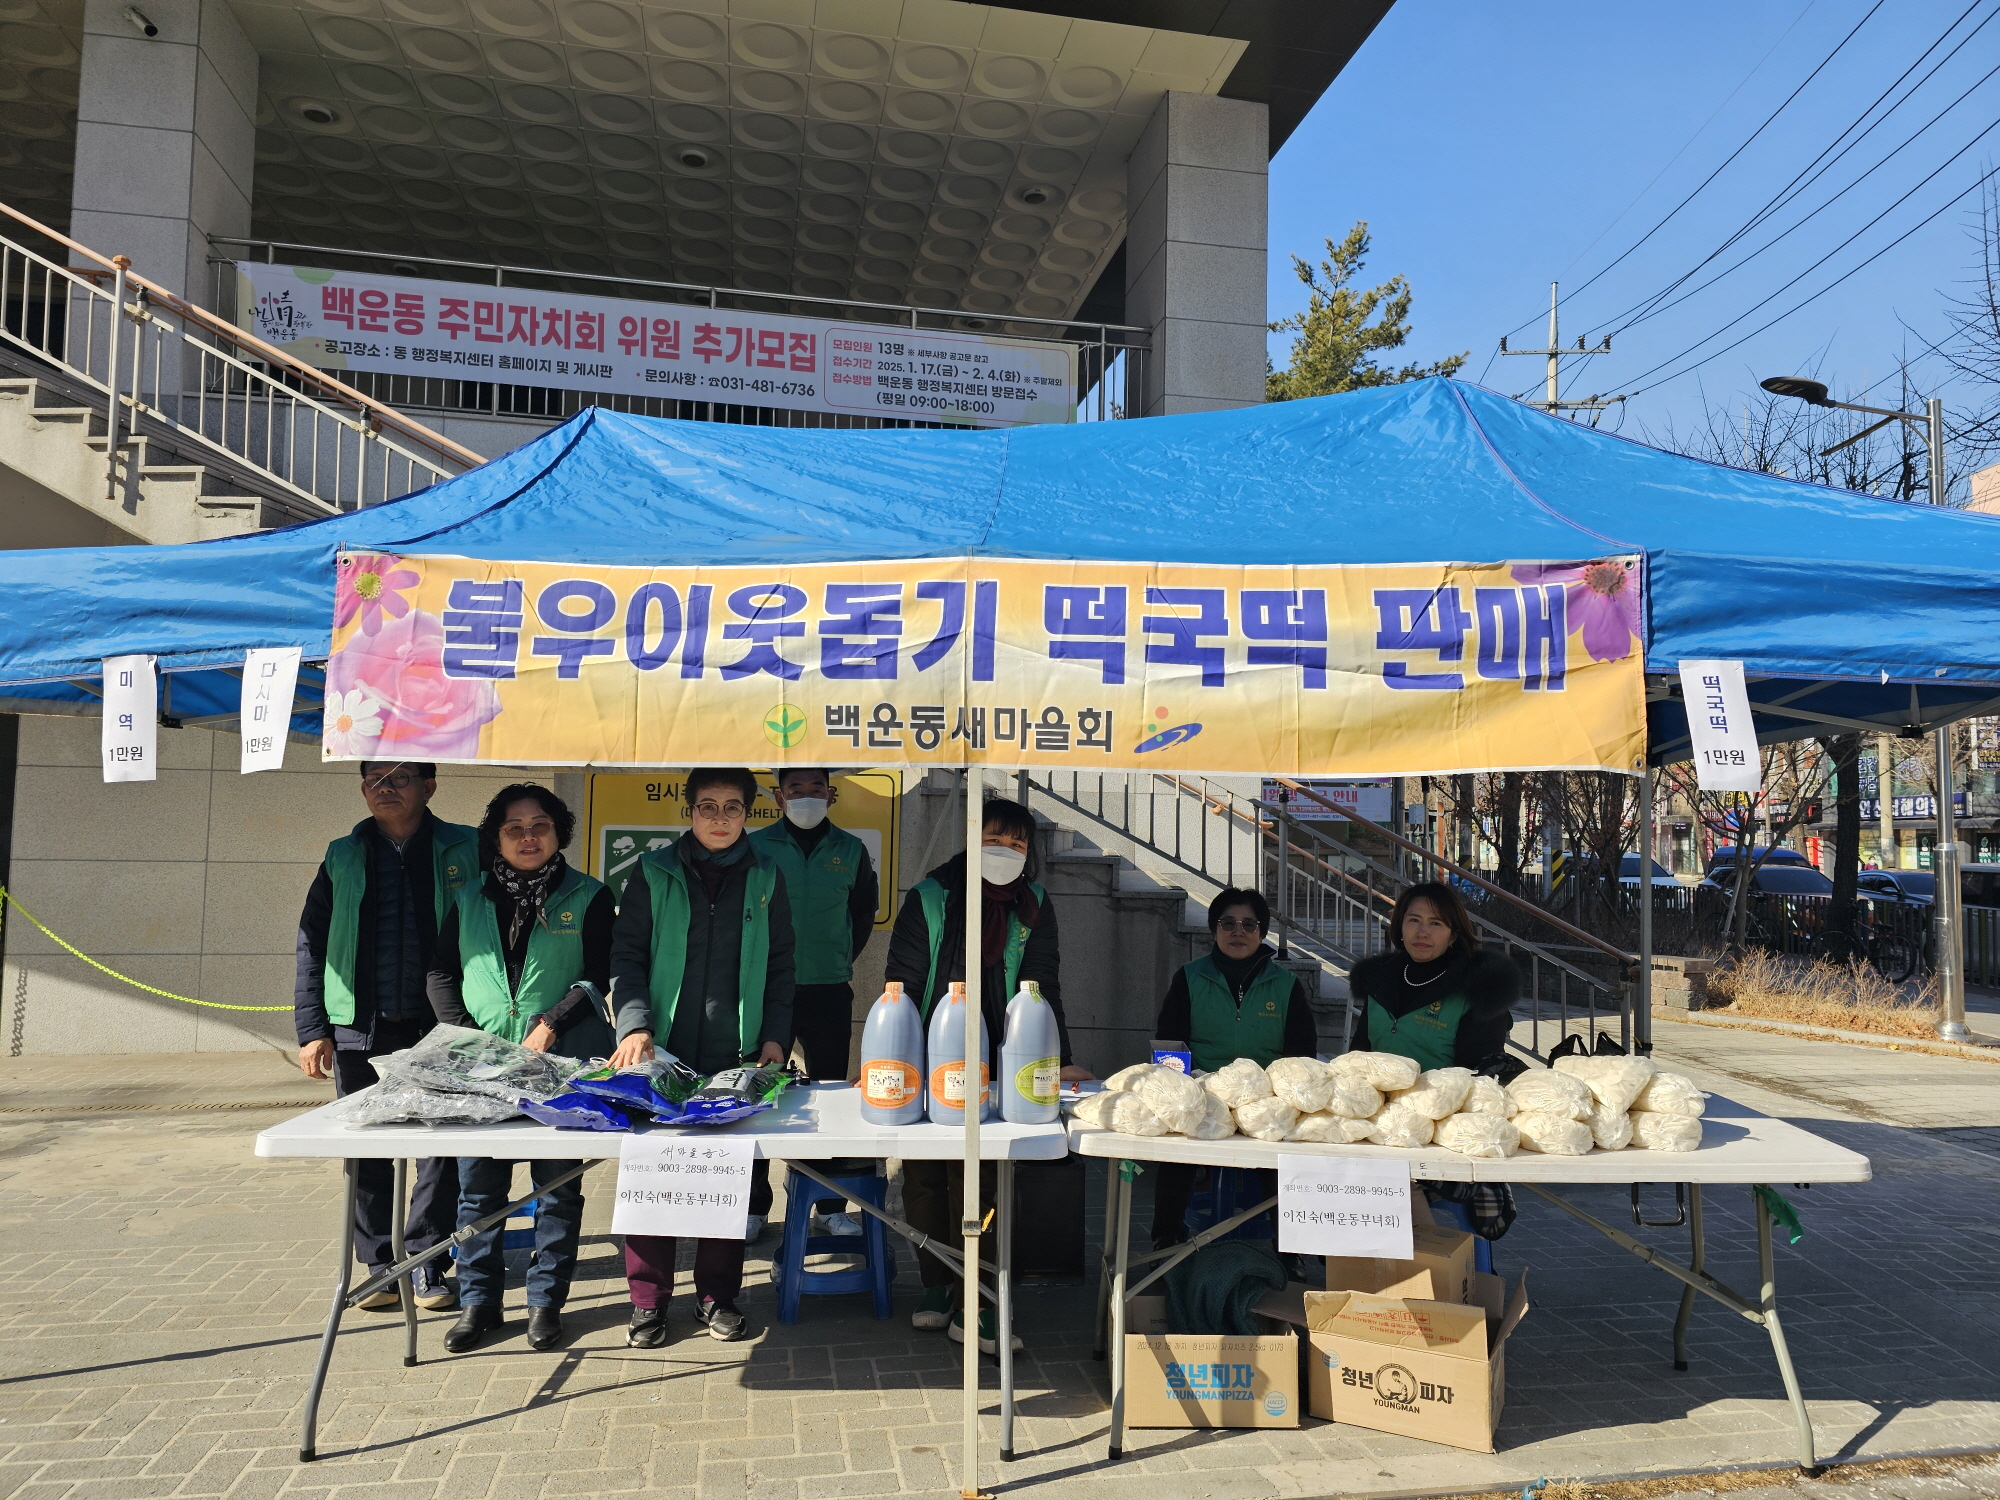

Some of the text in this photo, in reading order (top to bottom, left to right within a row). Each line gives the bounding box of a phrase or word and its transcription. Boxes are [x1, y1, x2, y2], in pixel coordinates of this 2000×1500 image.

[321, 286, 426, 335] 백운동
[437, 298, 605, 353] 주민자치회
[617, 315, 681, 361] 위원
[692, 323, 817, 373] 추가모집
[325, 339, 381, 358] 공고장소
[393, 345, 408, 360] 동
[412, 346, 494, 369] 행정복지센터
[498, 355, 552, 374] 홈페이지
[556, 360, 569, 374] 및
[573, 362, 613, 379] 게시판
[833, 339, 873, 353] 모집인원
[878, 342, 905, 356] 13명
[917, 349, 948, 360] 세부사항
[949, 352, 972, 361] 공고문
[645, 368, 697, 387] 문의사항
[833, 356, 873, 370] 접수기간
[877, 361, 906, 373] 2025.
[908, 361, 918, 374] 1.
[921, 362, 959, 378] 17.(금)
[972, 368, 984, 380] 2.
[987, 369, 1021, 384] 4.(화)
[832, 372, 1038, 401] 접수방법 백운동 행정복지센터 방문접수
[877, 391, 996, 415] (평일 09:00~18:00)
[442, 577, 1568, 692] 불우이웃돕기 떡국떡 판매
[118, 670, 133, 732] 미역
[253, 662, 278, 723] 다시마
[1702, 675, 1729, 734] 떡국떡
[825, 702, 1114, 753] 백운동새마을회
[109, 746, 143, 762] 1만원
[245, 736, 273, 754] 1만원
[1703, 749, 1746, 766] 1만원
[657, 1163, 747, 1176] 9003-2898-9945-5
[620, 1189, 738, 1208] 이진숙(백운동부녀회)
[1316, 1183, 1405, 1197] 9003-2898-9945-5
[1283, 1209, 1401, 1228] 이진숙(백운동부녀회)
[1165, 1361, 1255, 1389] 청년피자
[1341, 1366, 1455, 1404] 청년 피자
[1165, 1390, 1255, 1401] YOUNGMANPIZZA
[1373, 1397, 1420, 1414] YOUNGMAN
